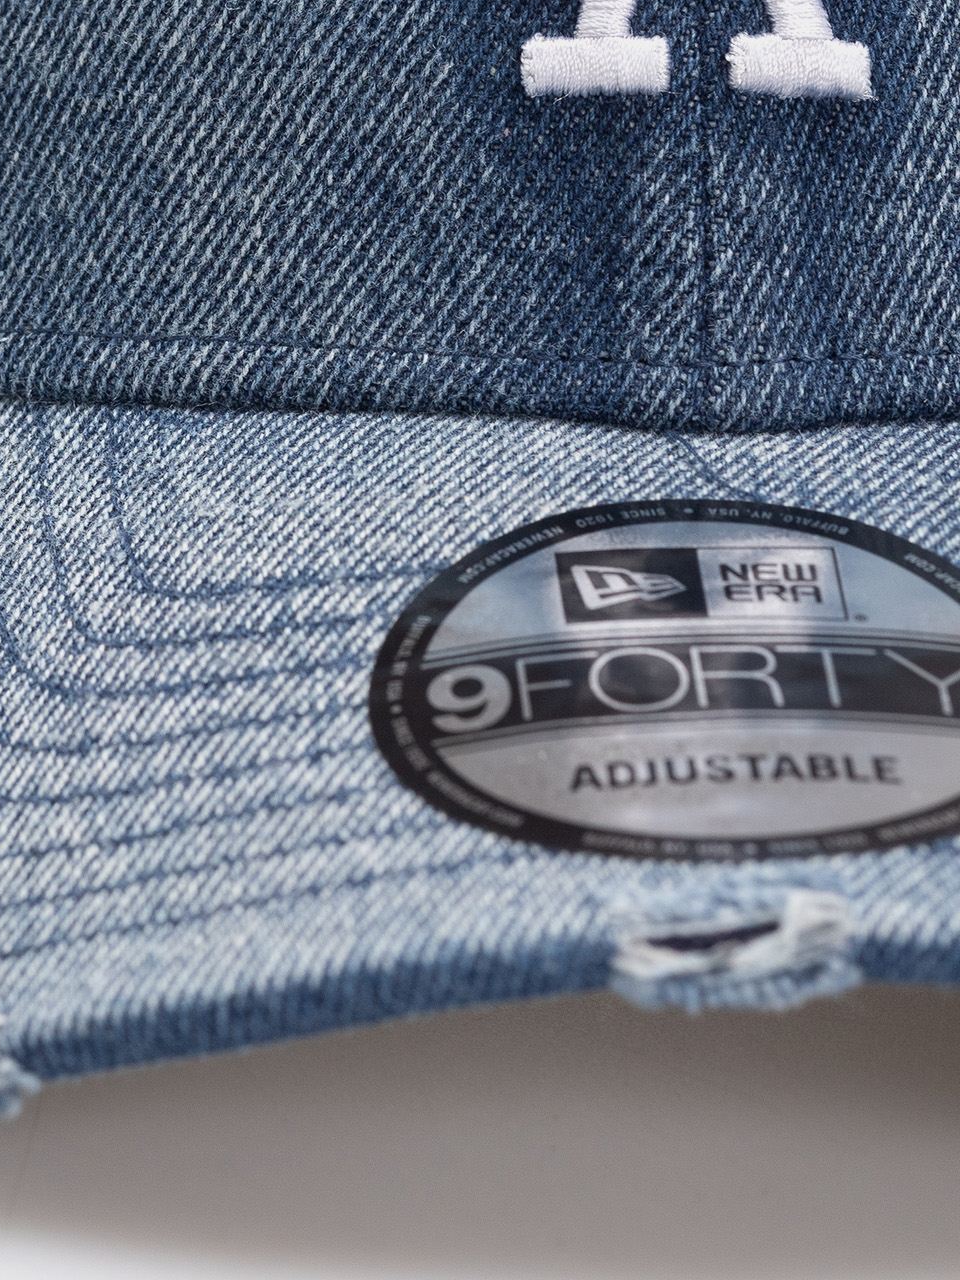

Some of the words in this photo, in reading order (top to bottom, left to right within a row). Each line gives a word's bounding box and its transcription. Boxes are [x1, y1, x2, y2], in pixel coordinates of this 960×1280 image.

[622, 507, 666, 521] SINCE
[707, 507, 739, 517] USA
[718, 562, 819, 584] NEW
[724, 584, 824, 604] ERA
[569, 753, 902, 794] ADJUSTABLE
